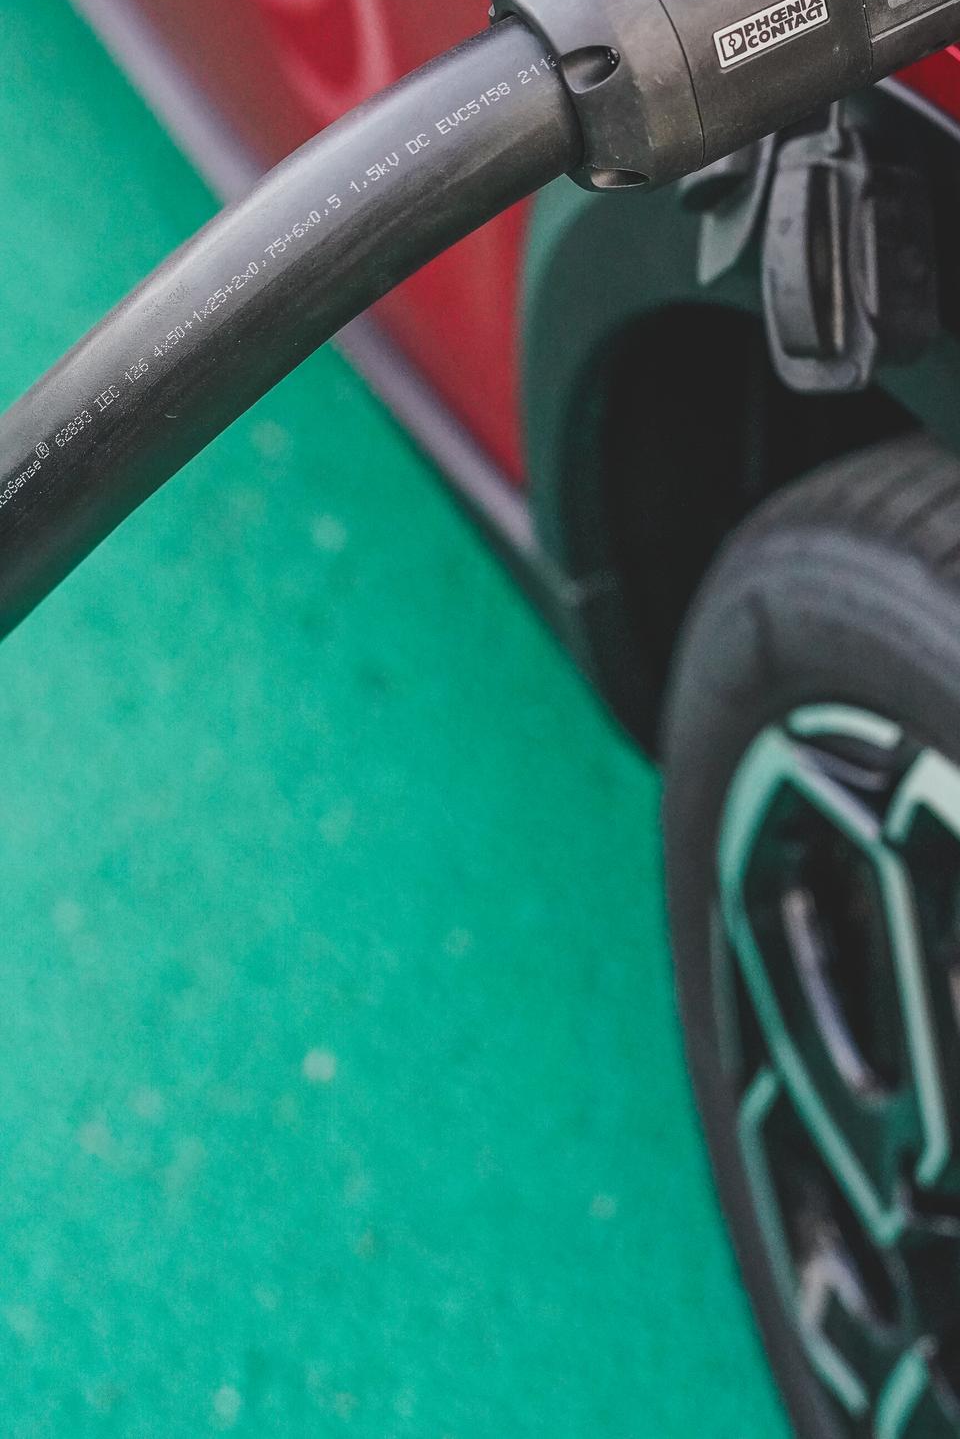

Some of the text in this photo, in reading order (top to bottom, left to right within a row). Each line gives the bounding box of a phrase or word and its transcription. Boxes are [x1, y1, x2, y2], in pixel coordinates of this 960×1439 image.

[747, 3, 824, 48] CONTACT
[55, 410, 92, 447] 62893
[93, 385, 120, 412] IEC
[125, 358, 149, 383] 126
[405, 133, 431, 155] DC
